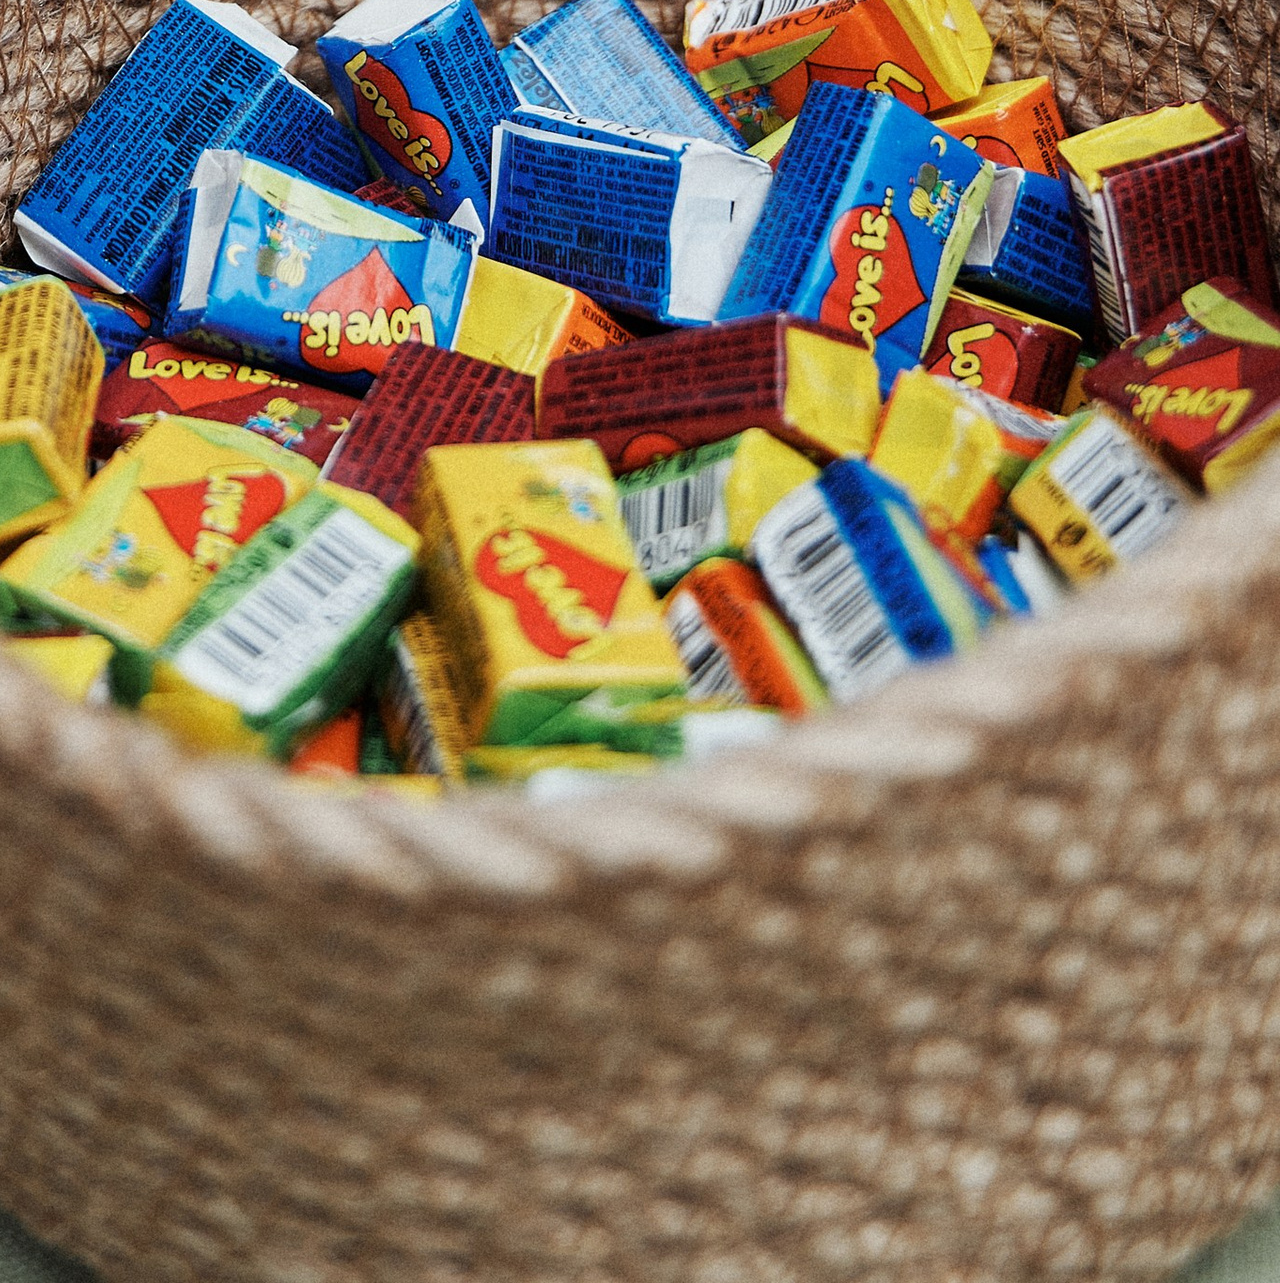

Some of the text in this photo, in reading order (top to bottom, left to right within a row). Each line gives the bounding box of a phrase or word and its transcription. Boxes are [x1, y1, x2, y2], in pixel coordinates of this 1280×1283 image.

[166, 5, 191, 34] SOKAK
[454, 23, 476, 57] COLOUR
[146, 15, 207, 91] АНТИОКИСЛИТЕЛЬ
[167, 21, 215, 80] СВЕКОЛЬНОГО
[180, 26, 223, 79] ЭМУЛЬГАТОР
[198, 32, 231, 71] ОСНОВА,
[204, 38, 248, 88] БАНАНА
[234, 51, 266, 85] LOVE
[138, 70, 152, 84] VE
[148, 75, 172, 103] СОКА,
[167, 67, 204, 113] РЕГУЛЯТОР
[226, 74, 249, 95] IS
[443, 63, 468, 101] GLUCOSE
[457, 61, 487, 111] EMULSIFIER
[115, 99, 154, 146] КРАСИТЕЛЬ
[169, 90, 237, 170] ЖЕВАТЕЛЬНАЯ
[344, 49, 443, 196] Love is...
[414, 37, 489, 183] AND STRAWBERRY FLAVOURED SOFT
[457, 97, 481, 131] SUGAR,
[105, 103, 164, 177] АРОМАТИЗАТОРЫ,
[124, 110, 172, 170] КИСЛОТНОСТИ
[37, 171, 62, 200] ГОДЕН
[67, 172, 87, 195] KENT
[136, 159, 185, 214] РЕЗИНКА
[138, 146, 170, 186] СОСТАВ:
[67, 173, 112, 228] КОНЦЕНТРАТ
[82, 193, 123, 244] РЕЗИНОВАЯ
[127, 203, 152, 227] СО
[97, 217, 142, 267] ВКУСОМ
[344, 303, 435, 347] Love
[128, 350, 233, 380] Love
[1163, 386, 1255, 434] Love
